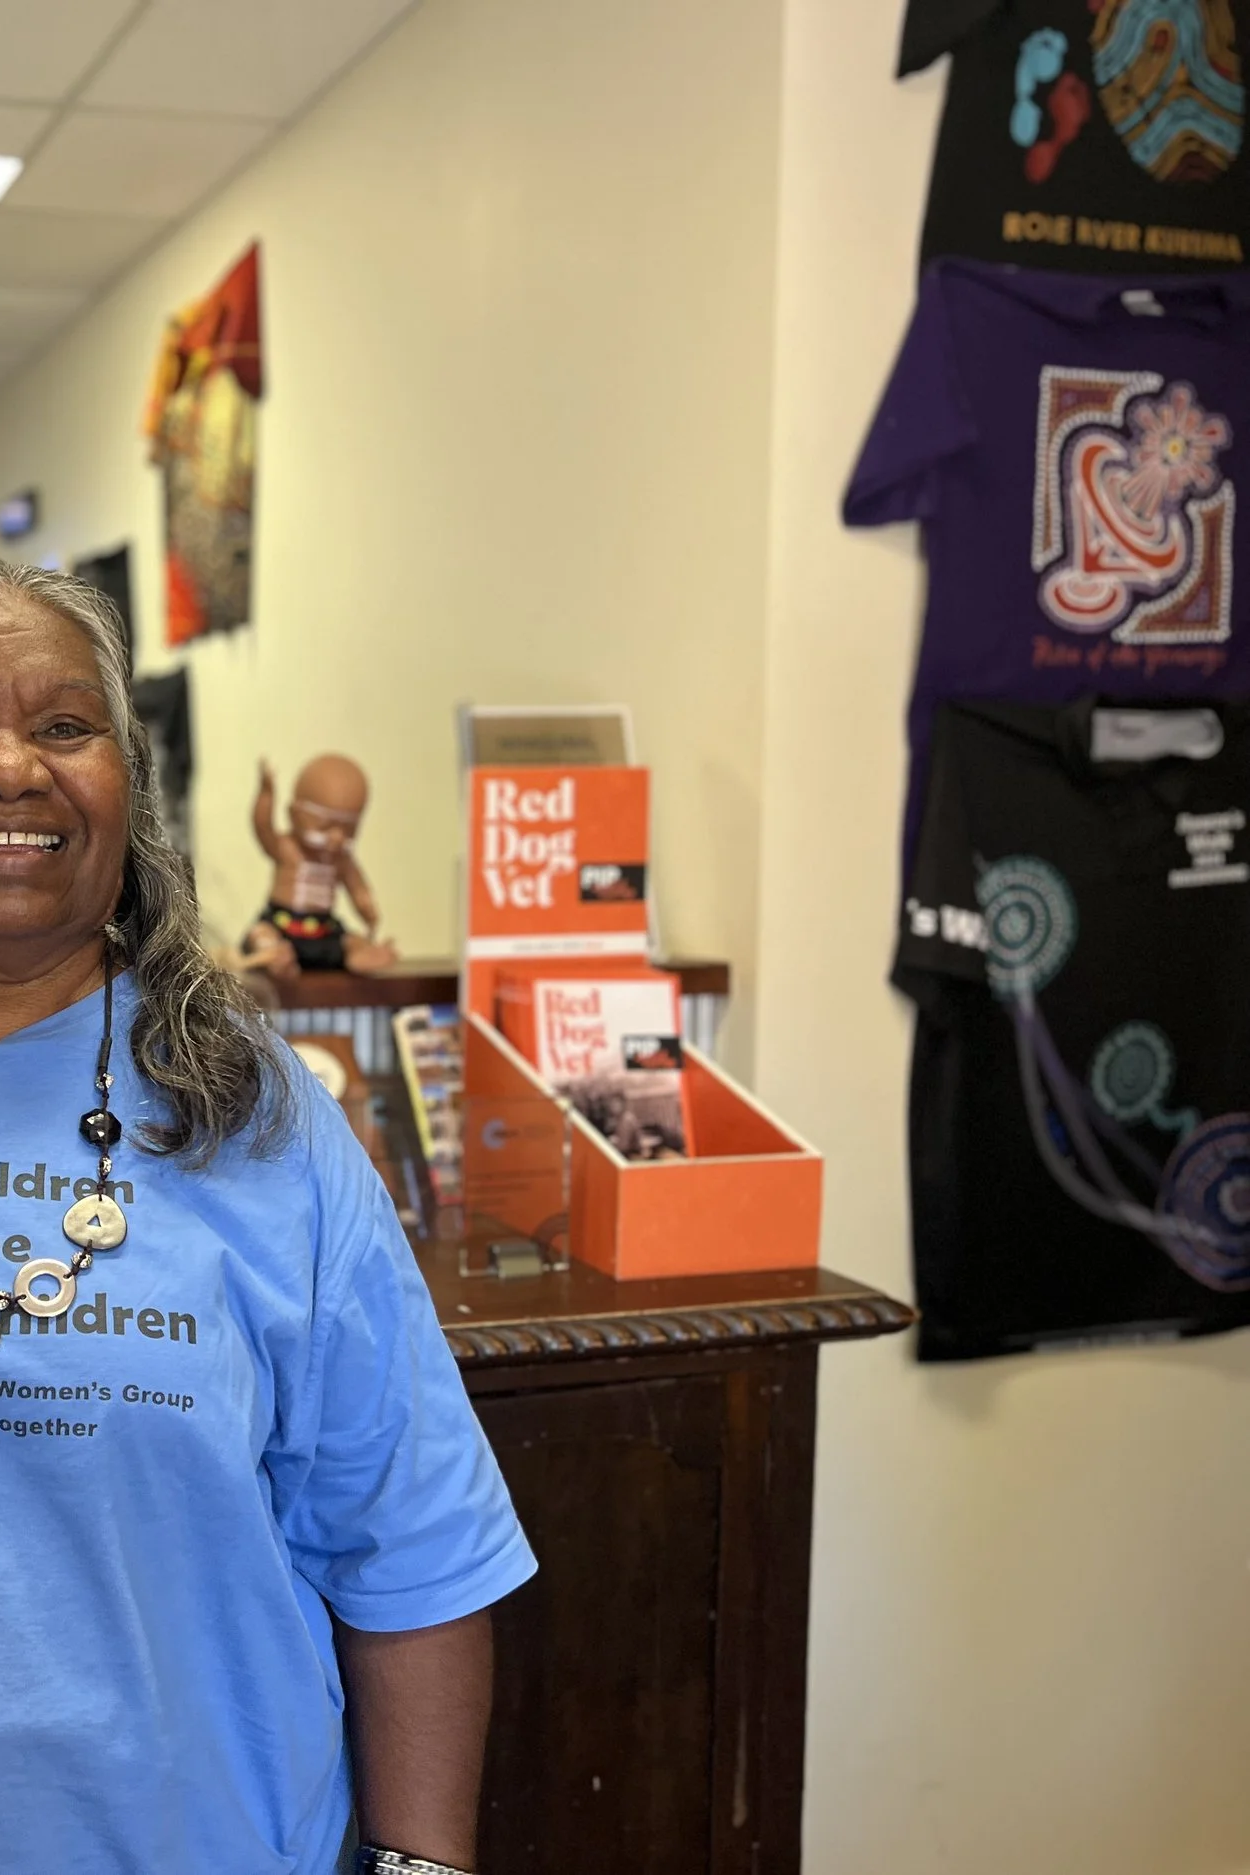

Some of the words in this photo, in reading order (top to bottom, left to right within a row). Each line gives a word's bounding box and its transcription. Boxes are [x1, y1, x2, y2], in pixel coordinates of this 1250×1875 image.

[484, 776, 575, 822] Red
[484, 823, 577, 874] Dog
[482, 866, 554, 910] Vet
[545, 988, 602, 1017] Red
[548, 1018, 607, 1048] Dog
[121, 1382, 195, 1413] Group
